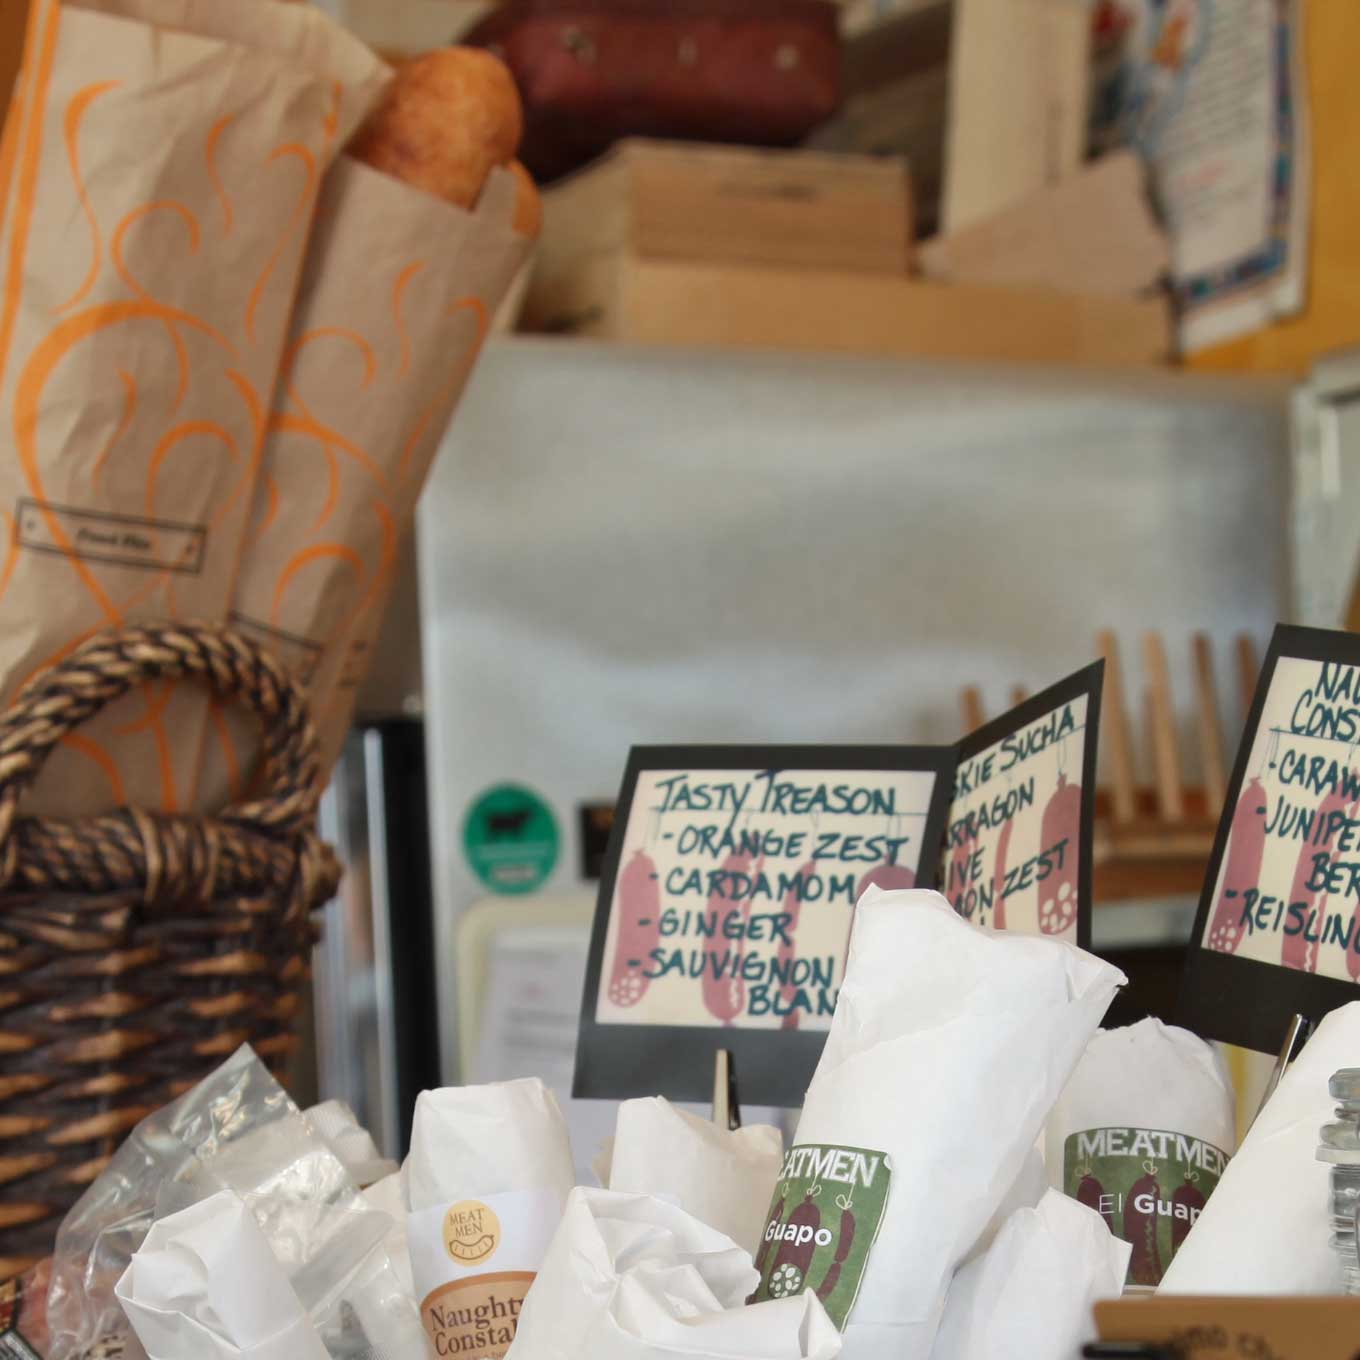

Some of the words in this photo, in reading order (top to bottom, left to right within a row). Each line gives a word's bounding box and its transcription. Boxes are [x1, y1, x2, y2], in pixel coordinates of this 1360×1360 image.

[954, 751, 994, 800] KIE
[656, 774, 749, 832] TASTY
[755, 767, 896, 816] TREASON
[950, 847, 985, 891] IVE
[1001, 838, 1069, 899] ZEST
[748, 986, 838, 1018] BLAN
[449, 1207, 485, 1226] MEAT
[1099, 1193, 1122, 1215] El
[1134, 1194, 1202, 1227] Guap
[455, 1222, 483, 1238] MEN
[765, 1219, 832, 1247] Guapo
[430, 1295, 524, 1331] Naught
